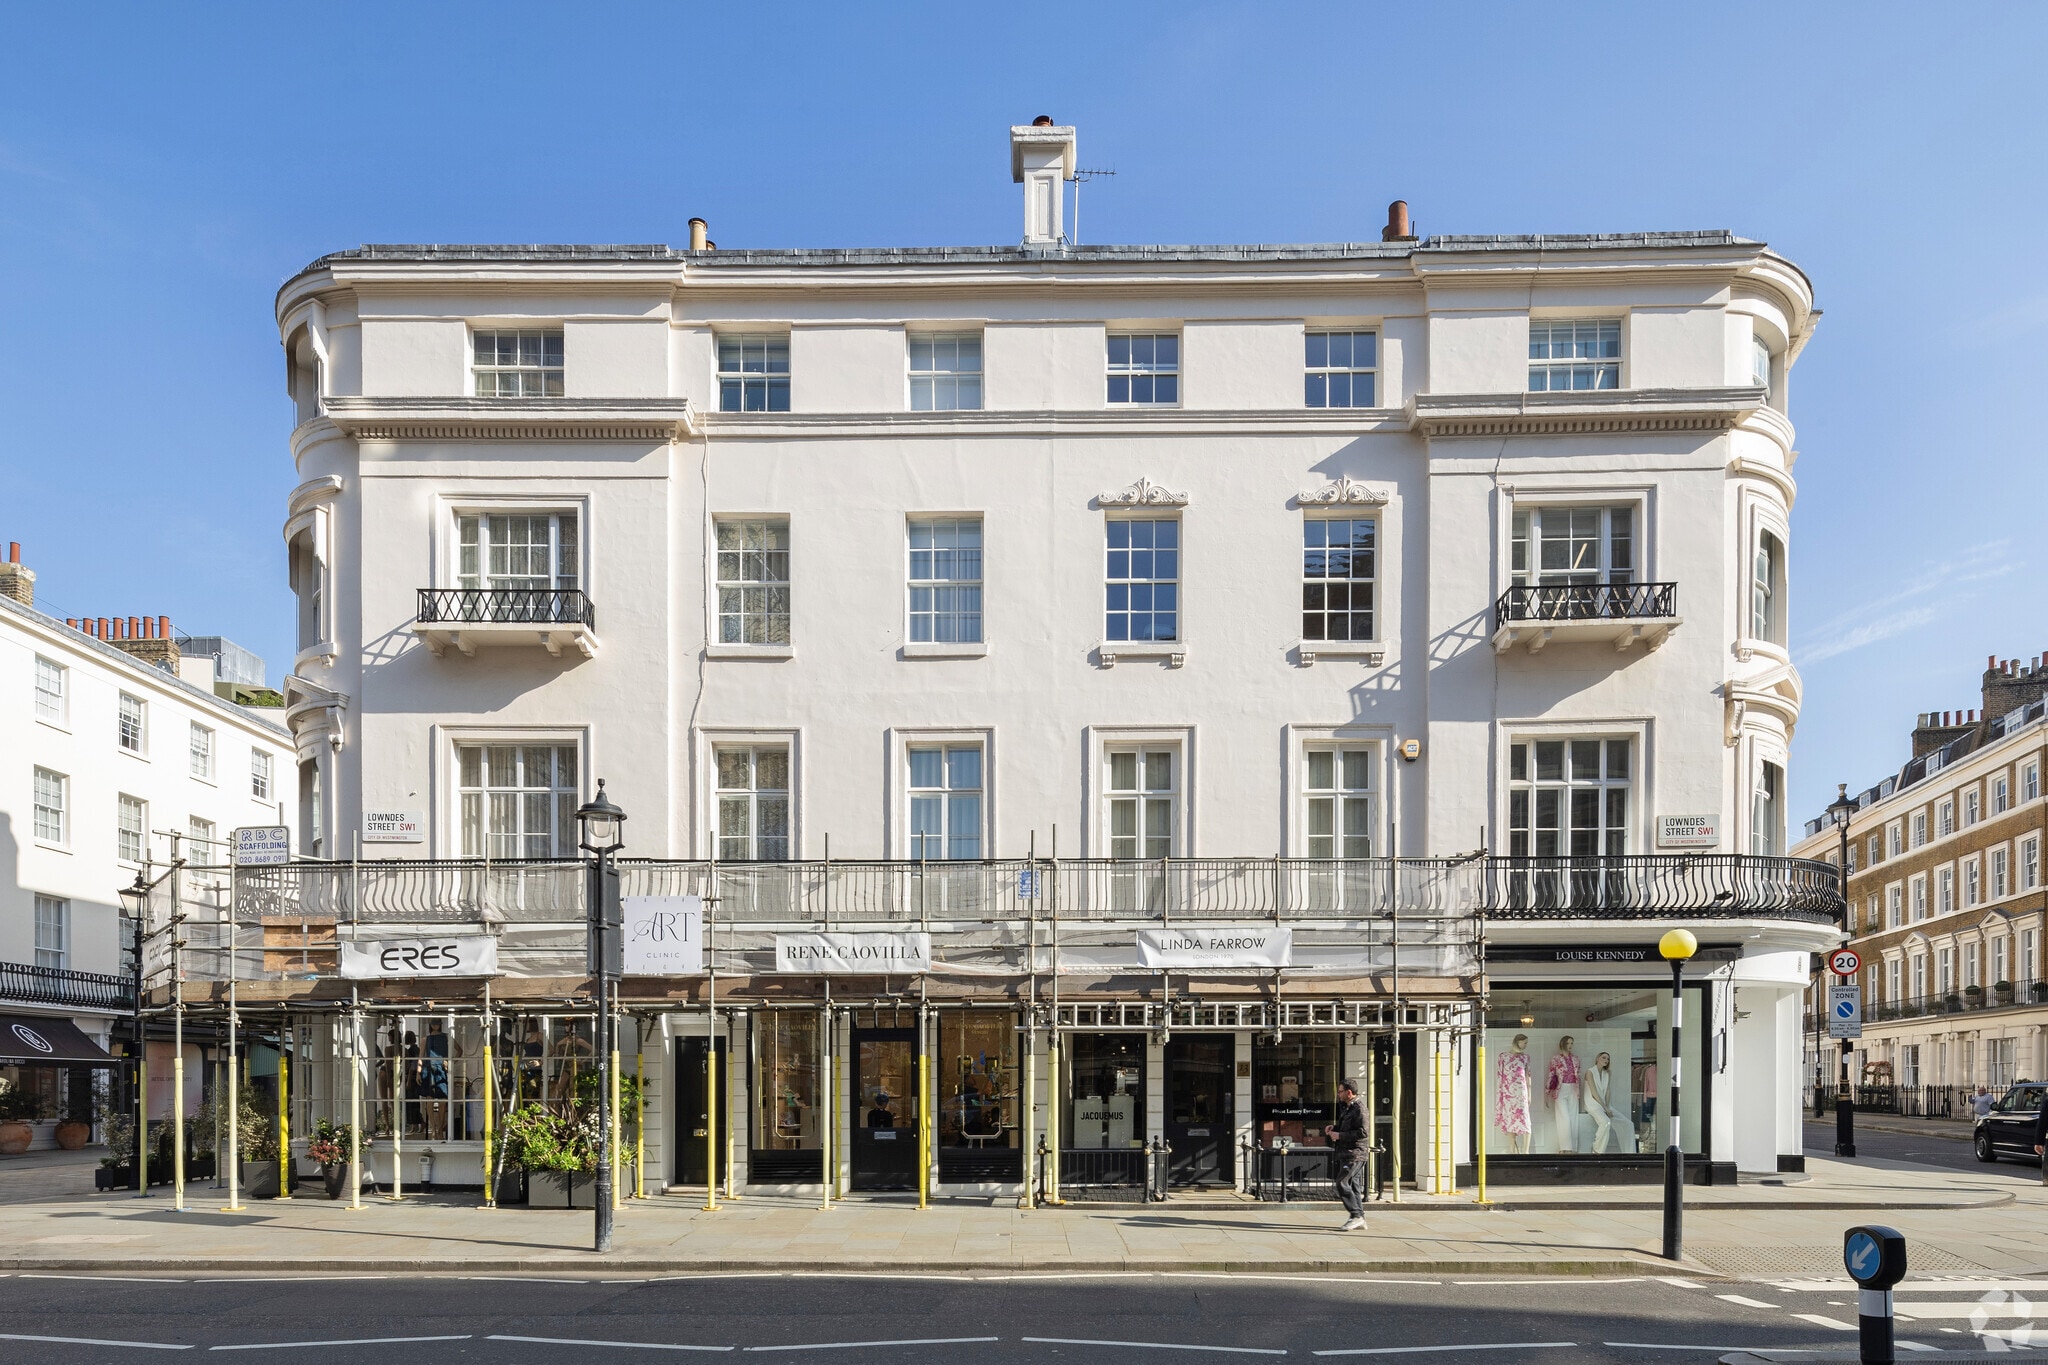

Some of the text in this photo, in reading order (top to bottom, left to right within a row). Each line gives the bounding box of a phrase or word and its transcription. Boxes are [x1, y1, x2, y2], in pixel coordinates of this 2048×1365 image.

[367, 813, 405, 821] LOWNDES
[1665, 817, 1705, 826] LOWNDES
[367, 822, 416, 831] STREET SW1
[1665, 827, 1714, 836] STREET SW1
[239, 842, 287, 850] SCAFFOLDING
[239, 856, 253, 864] 020
[631, 911, 696, 942] ART
[1160, 937, 1266, 950] LINDA FARROW
[786, 945, 833, 960] RENE
[837, 945, 922, 960] CAOVILLA
[1555, 951, 1646, 960] LOUISE KENNEDY
[380, 945, 460, 971] ERES
[1835, 957, 1857, 968] 20
[1080, 1111, 1124, 1121] JACQUEMUS
